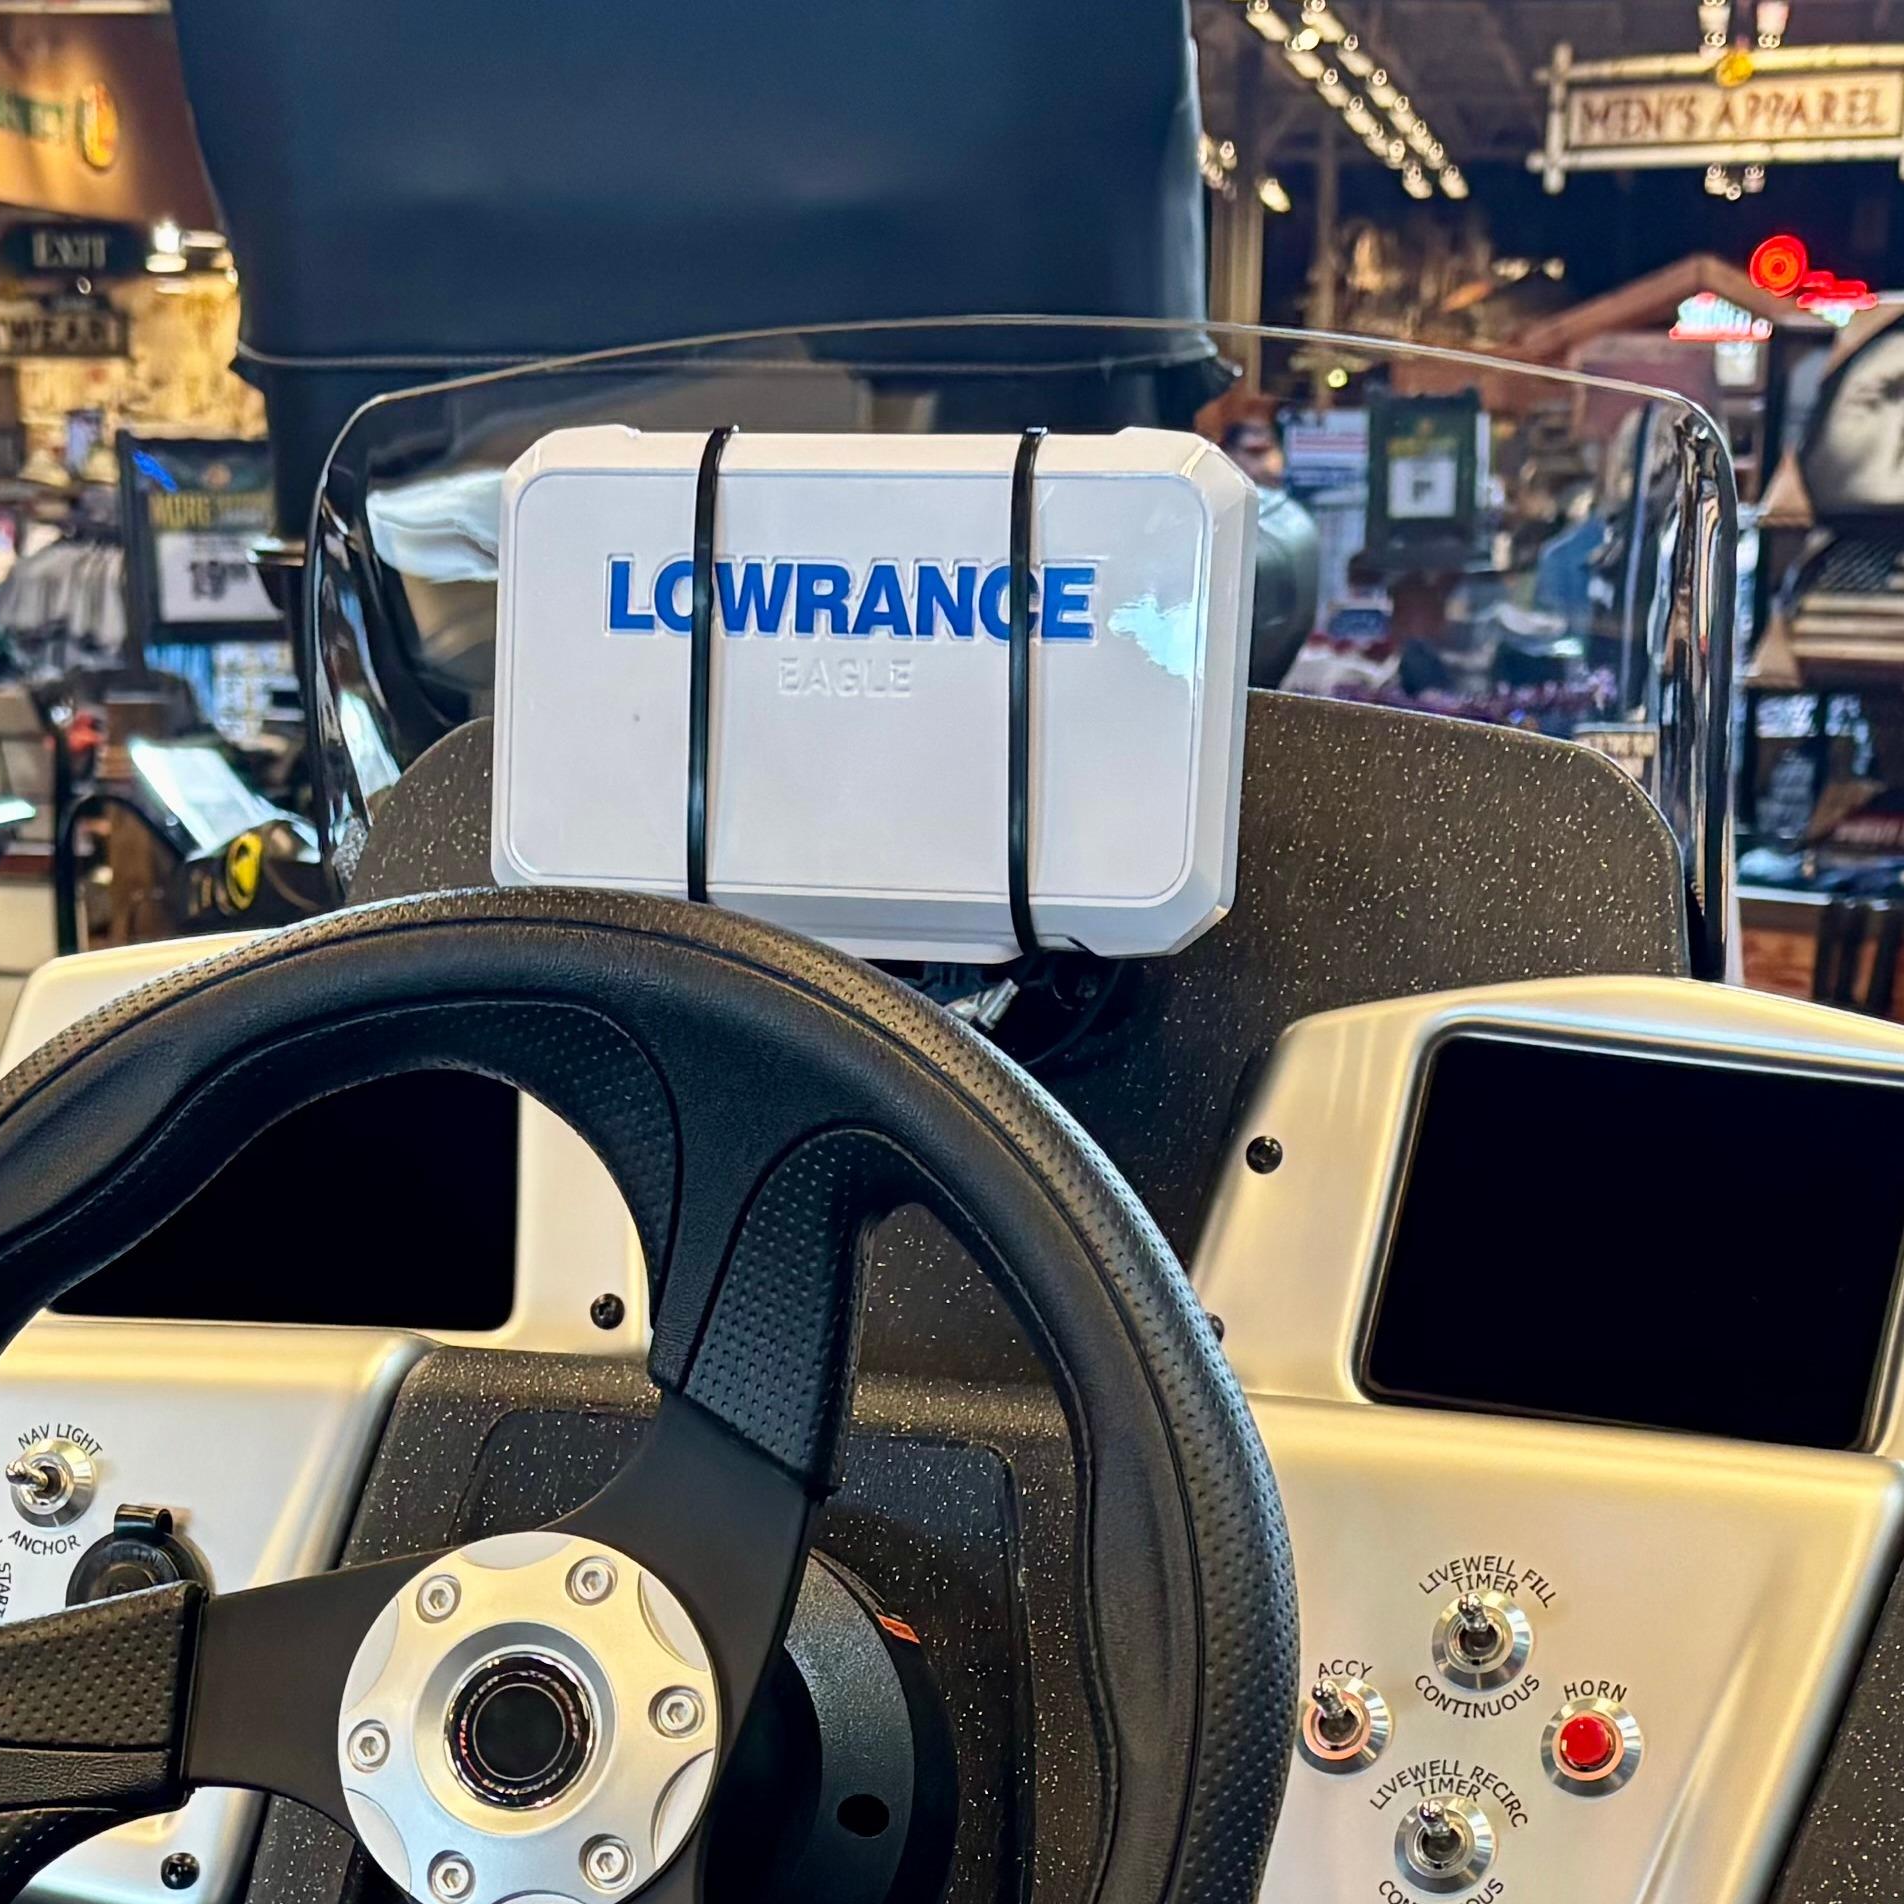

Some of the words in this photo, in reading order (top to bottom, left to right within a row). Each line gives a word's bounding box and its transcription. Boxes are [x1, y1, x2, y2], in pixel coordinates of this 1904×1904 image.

[1583, 95, 1696, 138] MEN'S
[1710, 88, 1890, 136] APPAREL
[607, 559, 1097, 643] LOWRANCE
[778, 657, 914, 698] EAGLE
[18, 1423, 51, 1450] NAV
[56, 1423, 103, 1457] LIGHT
[7, 1529, 82, 1556] ANCHOR
[1418, 1555, 1516, 1596] LIVEWELL
[1520, 1567, 1558, 1610] FILL
[1450, 1573, 1520, 1598] TIMER
[1317, 1658, 1375, 1679] ACCY
[1414, 1673, 1541, 1719] CONTINUOUS
[1563, 1679, 1628, 1702] HORN
[1369, 1759, 1464, 1811] LIVEWELL
[1469, 1766, 1529, 1829] RECIRC
[1412, 1777, 1482, 1802] TIMER
